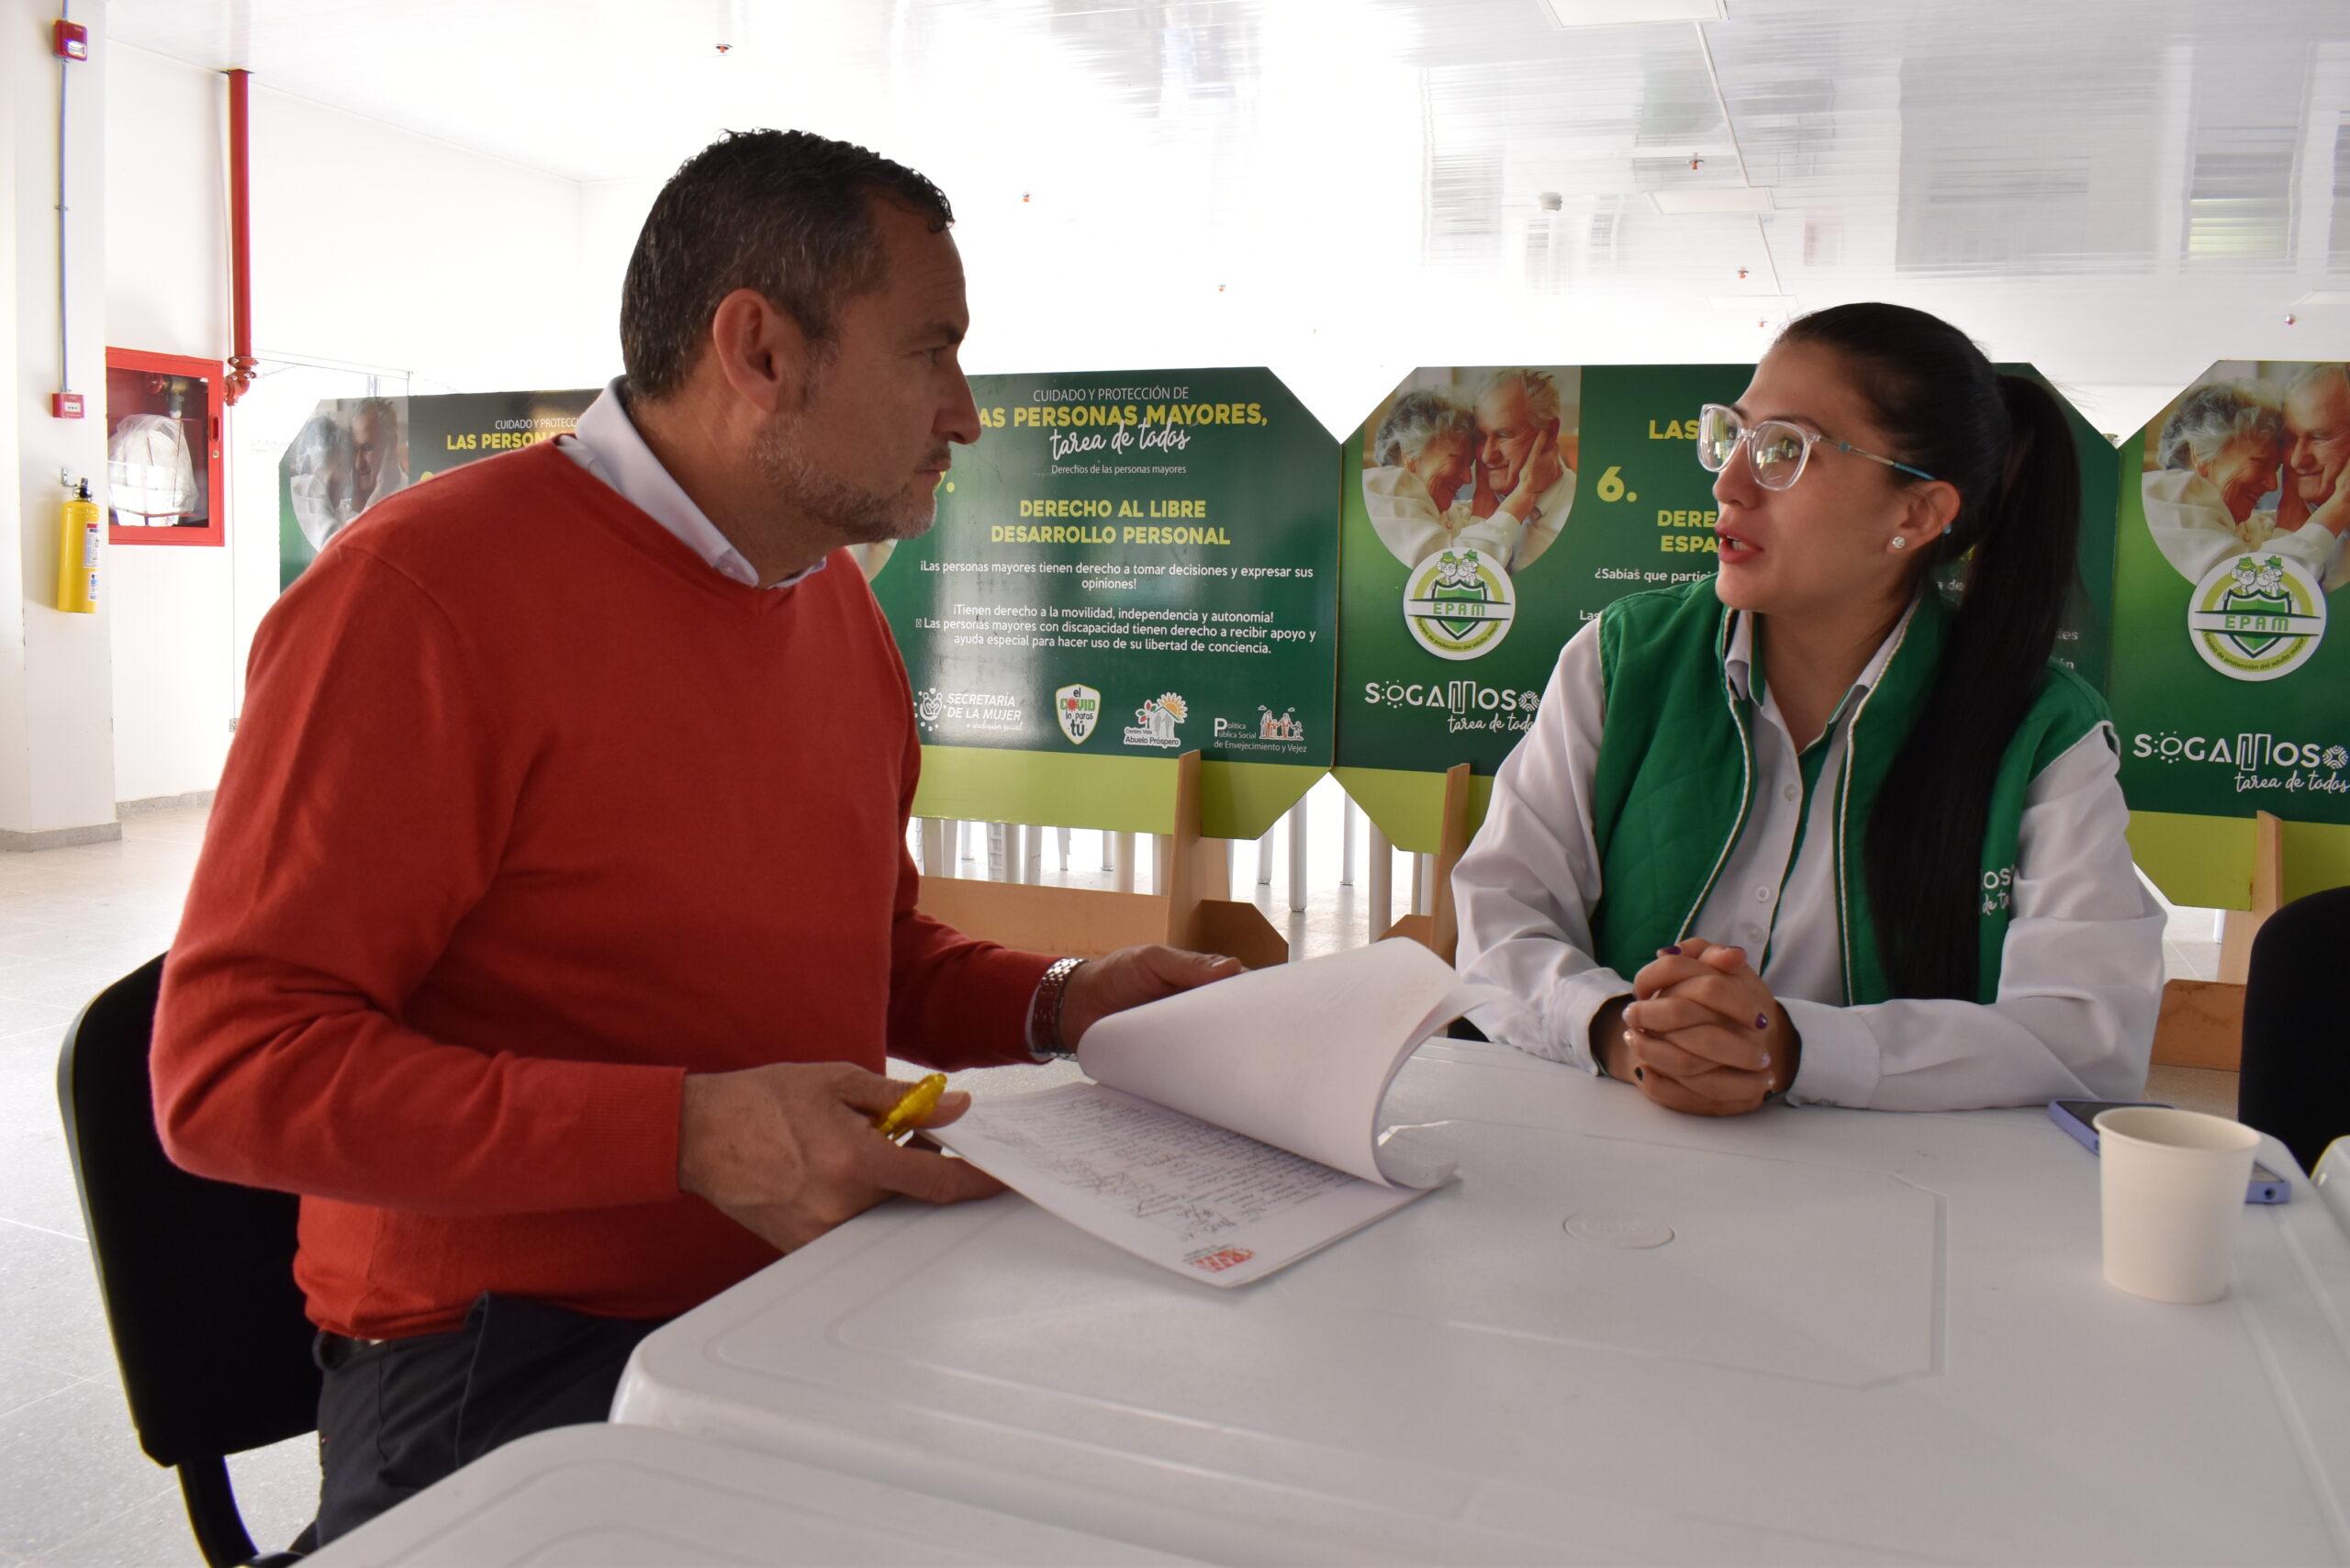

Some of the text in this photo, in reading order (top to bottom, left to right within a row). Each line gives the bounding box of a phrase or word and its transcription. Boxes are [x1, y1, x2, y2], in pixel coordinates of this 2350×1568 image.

[1034, 385, 1189, 402] CUIDADO Y PROTECCIÓN DE
[979, 403, 1268, 428] AS PERSONAS MAYORES,
[495, 420, 532, 430] CUIDADO
[533, 420, 540, 428] Y
[1649, 420, 1699, 440] LAS
[447, 431, 553, 450] LAS PERSON
[1049, 416, 1191, 461] tarea de todos
[1051, 464, 1186, 476] Derechos de las personas mayores
[1596, 465, 1638, 502] 6.
[1020, 500, 1206, 518] DERECHO AL LIBRE
[1657, 510, 1717, 528] DERE
[991, 525, 1231, 545] DESARROLLO PERSONAL
[1661, 535, 1718, 553] ESPA
[943, 562, 989, 574] personas
[991, 563, 1035, 576] mayores
[1039, 561, 1072, 573] tienen
[1075, 563, 1120, 575] derecho
[1124, 566, 1130, 575] a
[1134, 565, 1166, 576] tomar
[1169, 564, 1228, 577] decisiones
[1231, 566, 1238, 579] y
[1241, 566, 1291, 579] expresar
[1294, 567, 1313, 577] sus
[1595, 567, 1640, 579] ¿Sabías
[1644, 571, 1667, 583] que
[1081, 578, 1136, 591] opiniones!
[993, 605, 1037, 617] derecho
[1040, 608, 1046, 617] a
[1049, 606, 1058, 617] la
[1061, 606, 1115, 620] movilidad,
[1119, 608, 1199, 622] independencia
[1202, 612, 1208, 624] y
[1211, 610, 1273, 622] autonomía!
[1433, 601, 1484, 616] EPAM
[924, 618, 1316, 643] Las personas mayores con discapacidad tienen derecho a recibir apoyo y
[2225, 615, 2289, 632] EPAM
[954, 633, 1271, 654] ayuda especial para hacer uso de su libertad de conciencia.
[947, 692, 1015, 707] SECRETARÍA
[1073, 687, 1081, 698] el
[946, 707, 1022, 721] DE LA MUJER
[1066, 711, 1094, 722] lo paras
[1448, 712, 1535, 733] tarea de todo
[1070, 719, 1085, 736] tú
[1125, 735, 1180, 747] Abuelo Próspero
[1225, 742, 1281, 753] Envejecimiento
[1281, 745, 1286, 753] y
[1287, 745, 1307, 753] Vejez
[2234, 770, 2350, 793] tarea de todos
